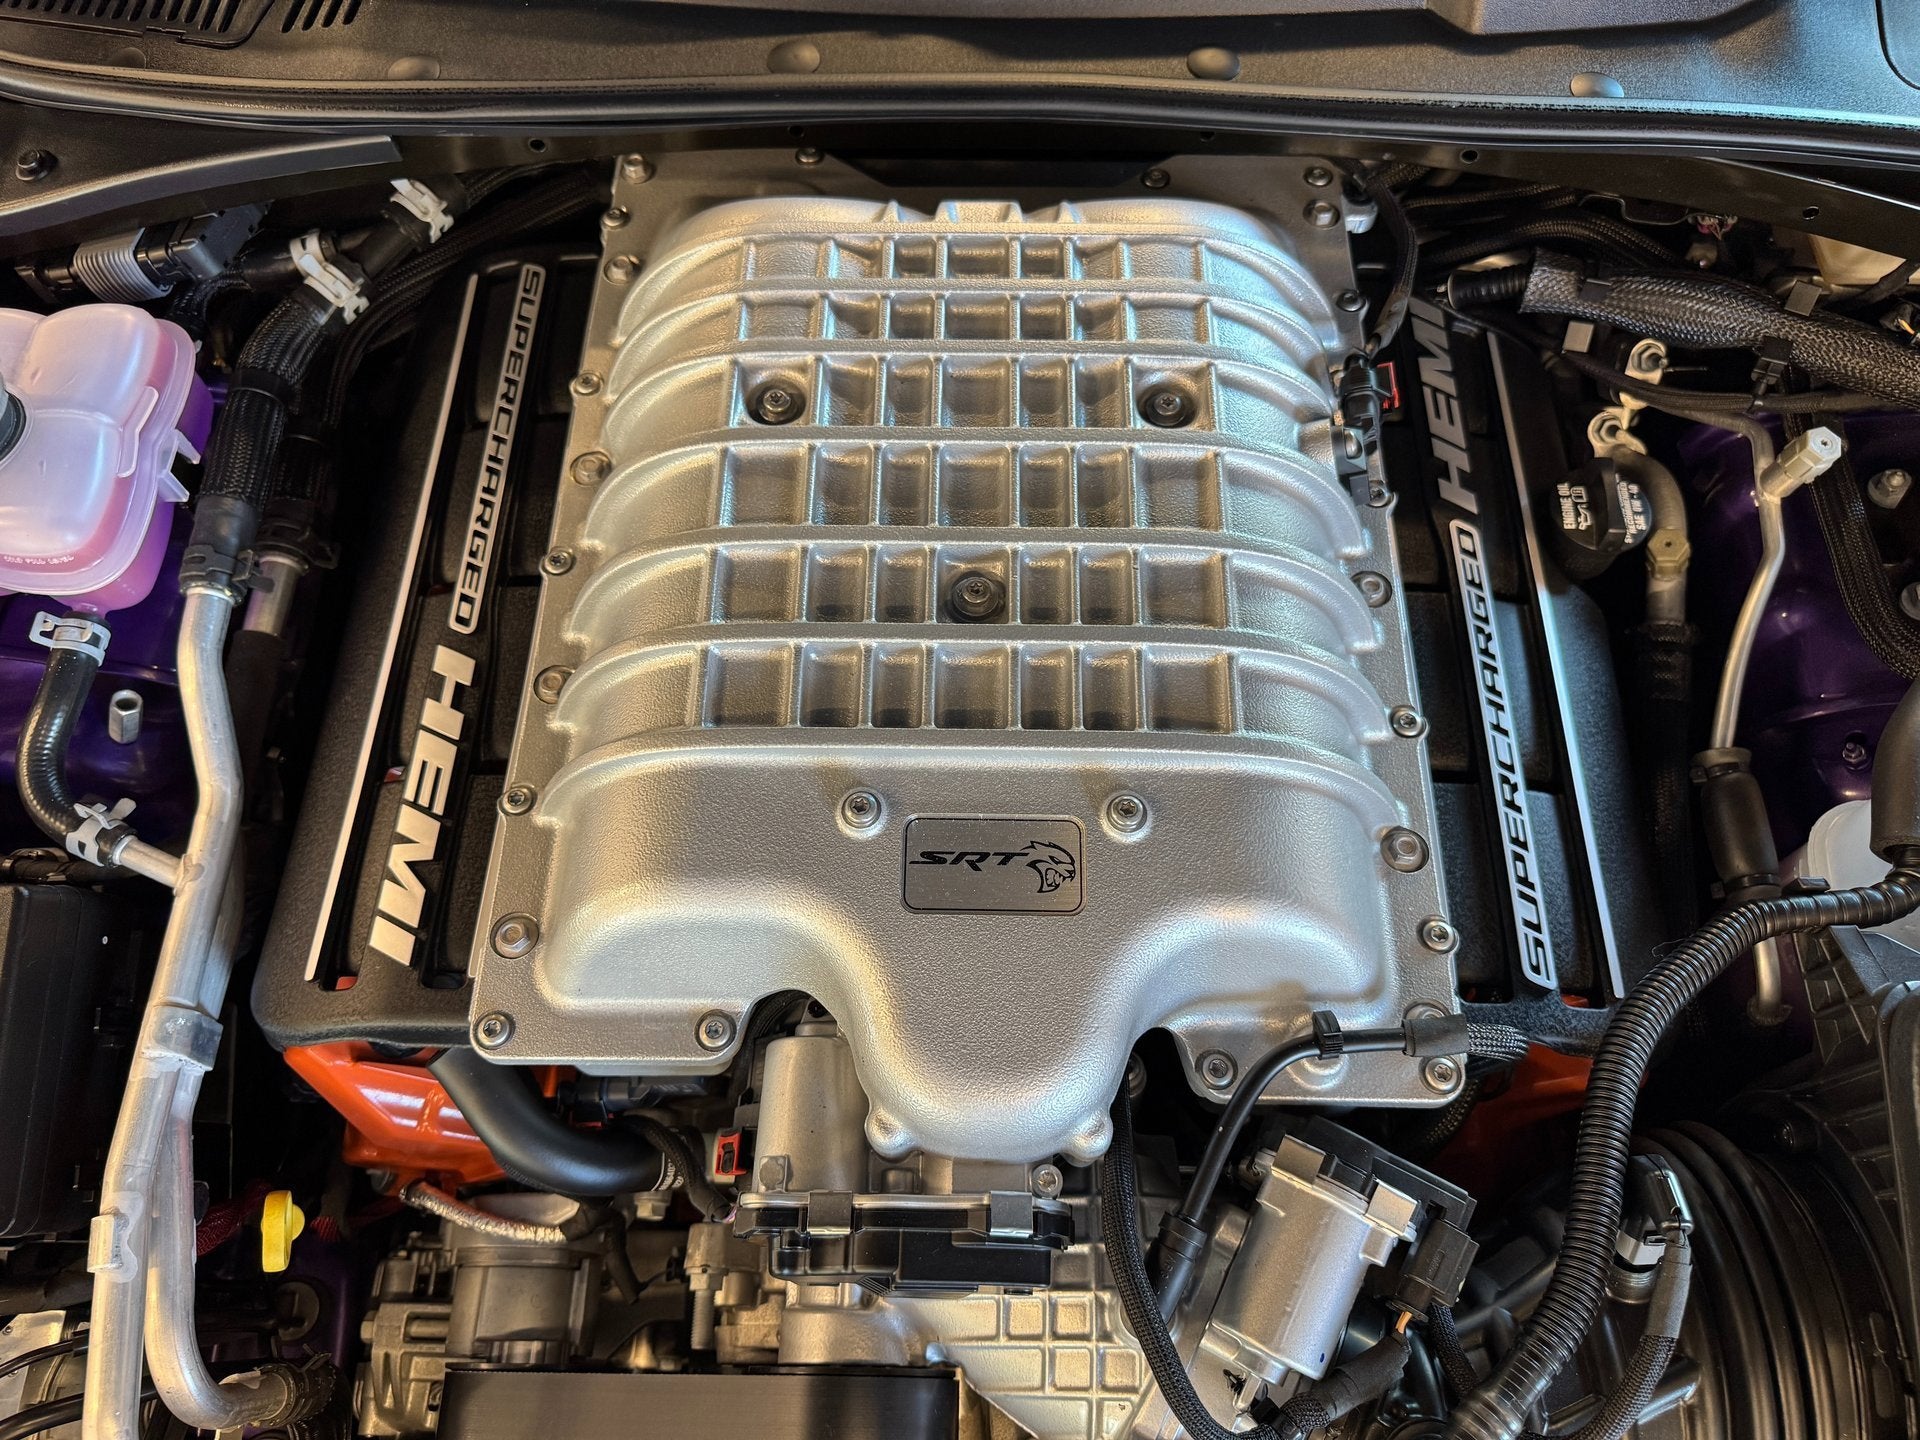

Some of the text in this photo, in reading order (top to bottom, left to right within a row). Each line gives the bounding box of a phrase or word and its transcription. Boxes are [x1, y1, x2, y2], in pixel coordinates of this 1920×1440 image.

[1557, 482, 1577, 530] ENGINE OIL
[1634, 514, 1647, 530] SAE
[369, 266, 543, 966] SUPERCHARGED HEMI
[1408, 297, 1553, 987] SUPERCHARGED HEMI
[909, 851, 1030, 871] SRT
